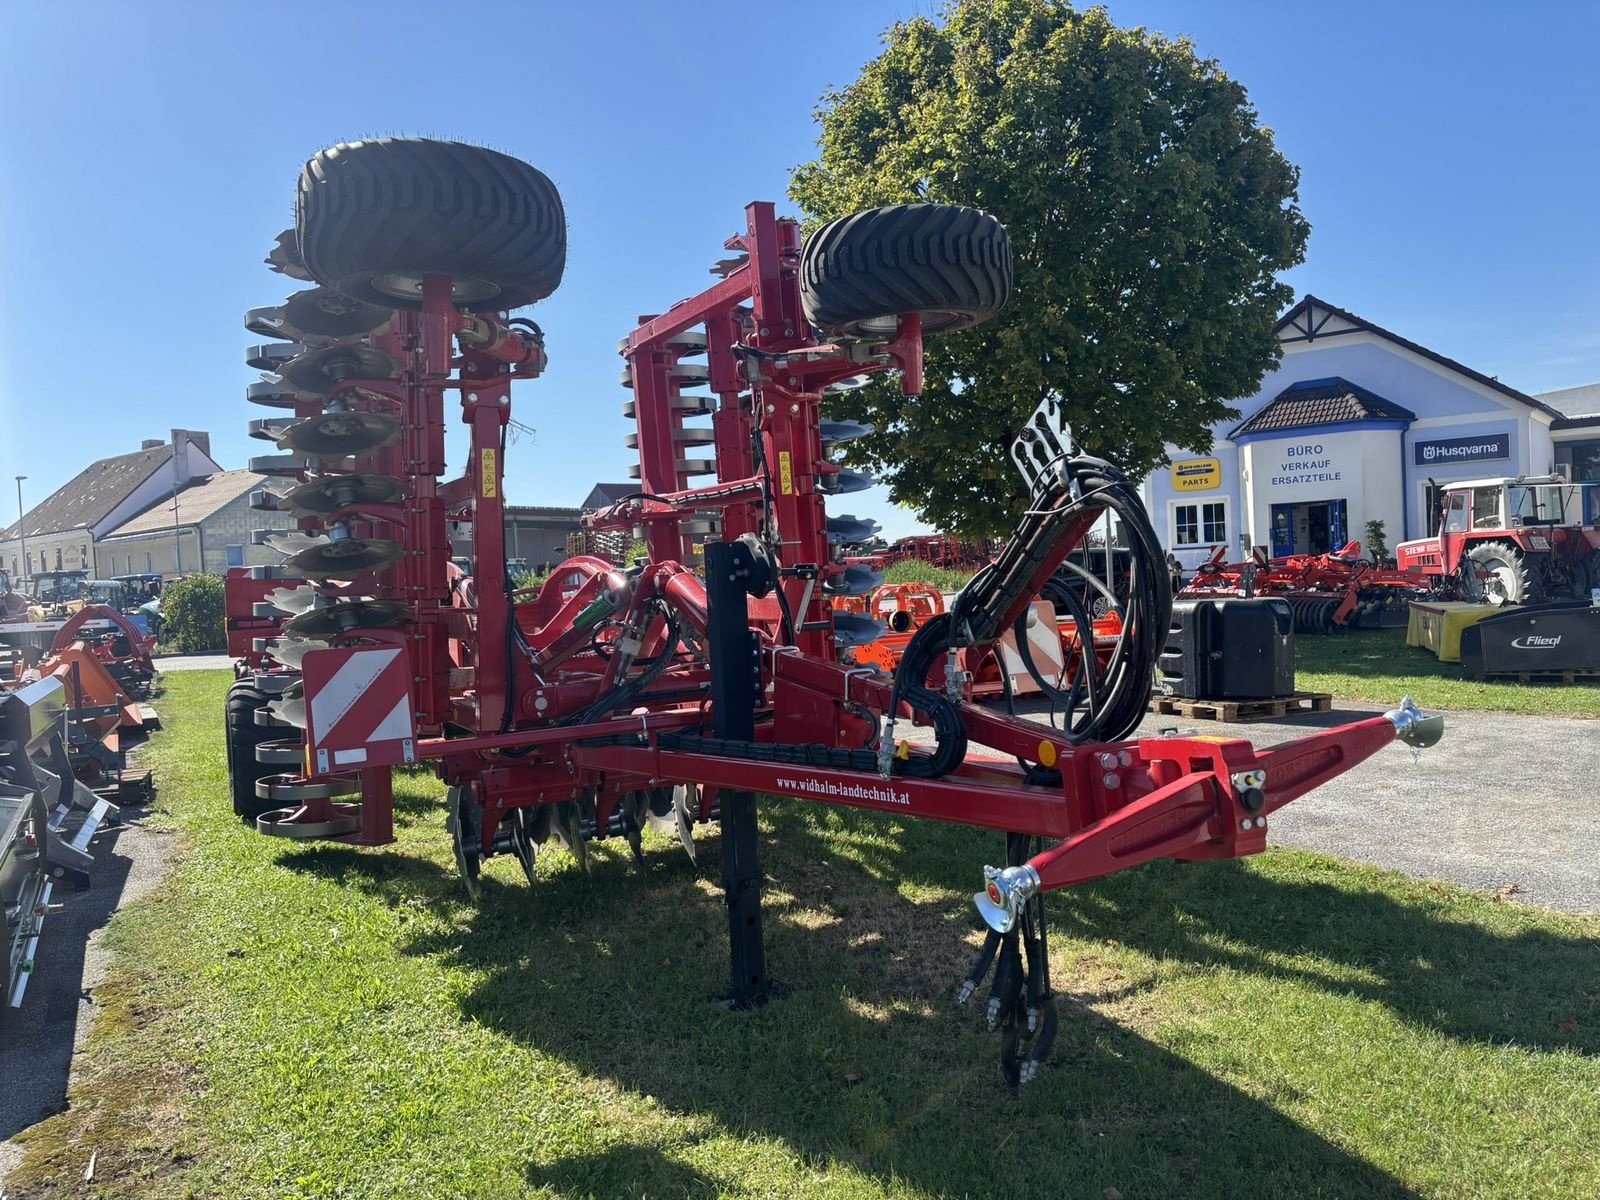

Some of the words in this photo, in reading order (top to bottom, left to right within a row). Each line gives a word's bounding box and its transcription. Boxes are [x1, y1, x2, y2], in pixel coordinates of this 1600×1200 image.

[1287, 444, 1323, 457] BÜRO
[1436, 443, 1498, 457] Husqvarna
[1281, 459, 1331, 471] VERKAUF
[1182, 477, 1209, 487] PARTS
[1271, 472, 1342, 485] ERSATZTEILE
[1405, 545, 1425, 556] STEYR
[1526, 635, 1562, 646] Fliegl
[776, 778, 910, 805] www.widhalm-landtechnik.at
